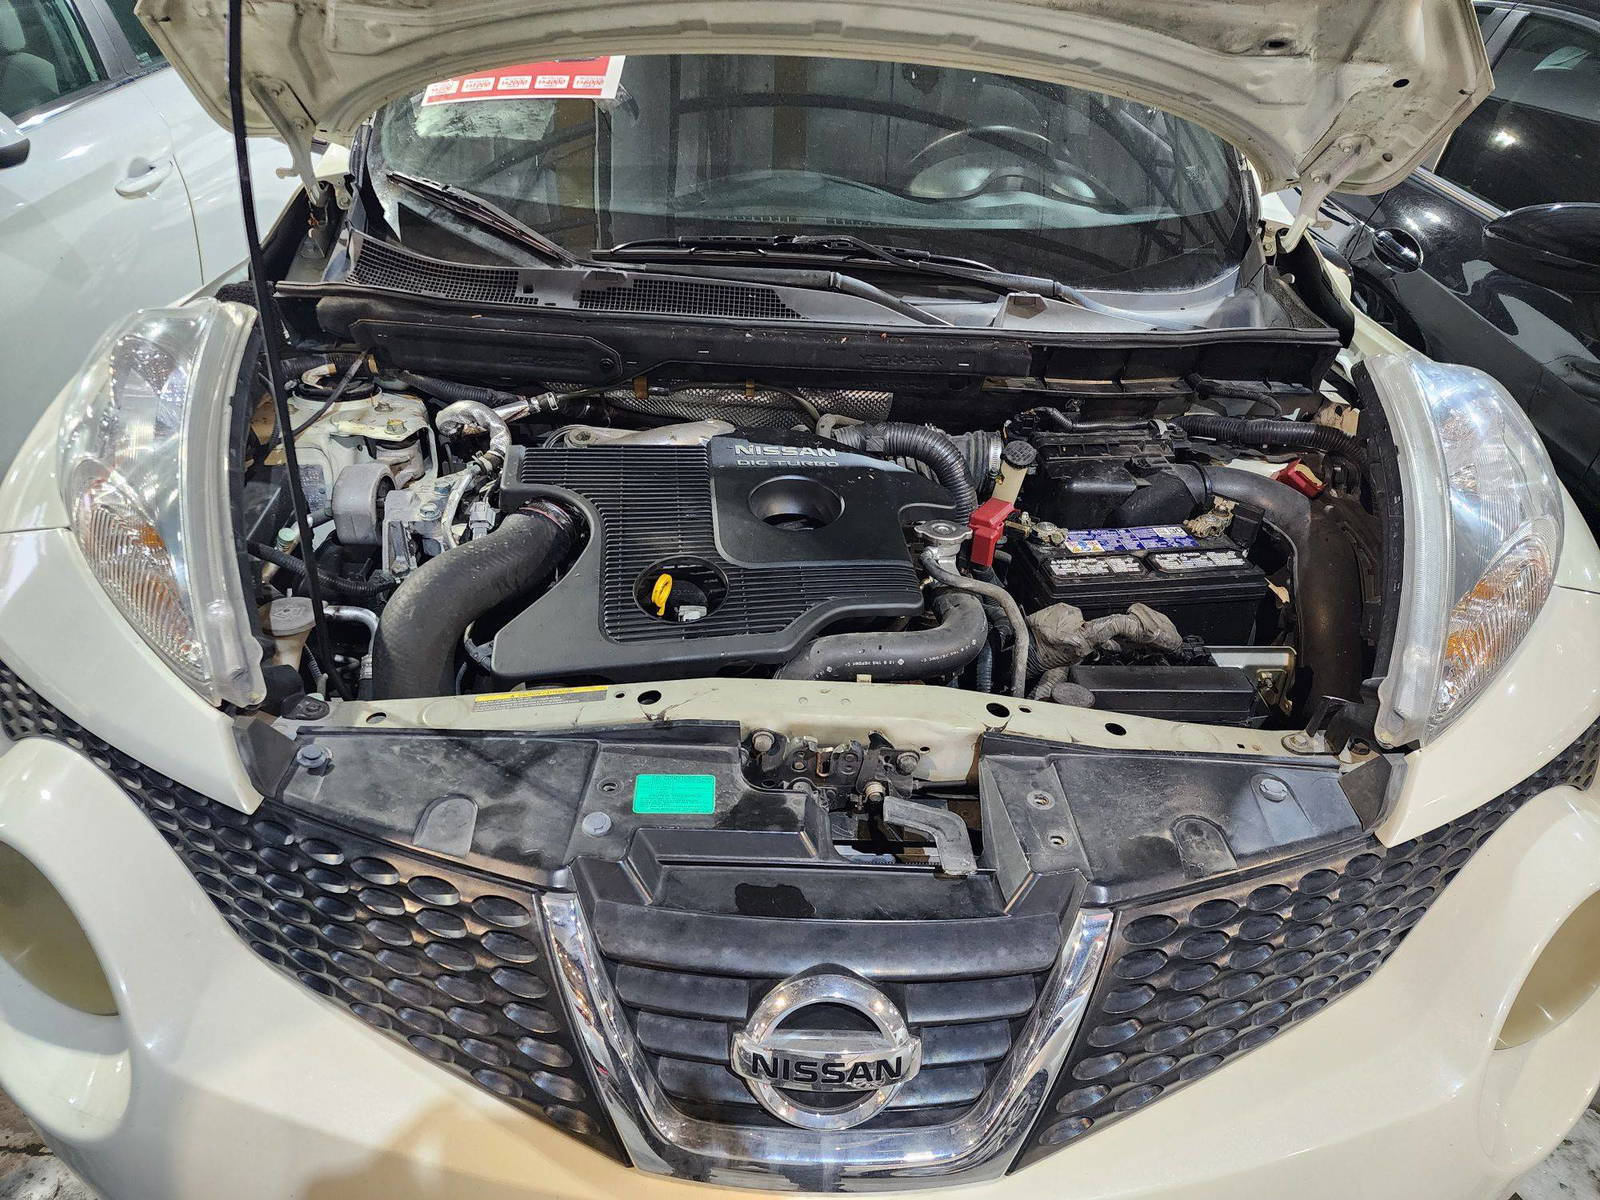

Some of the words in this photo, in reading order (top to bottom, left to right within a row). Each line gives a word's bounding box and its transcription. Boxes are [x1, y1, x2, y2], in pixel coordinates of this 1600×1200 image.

[734, 444, 837, 457] NISSAN
[773, 460, 840, 468] TURBO
[751, 1053, 902, 1084] NISSAN
